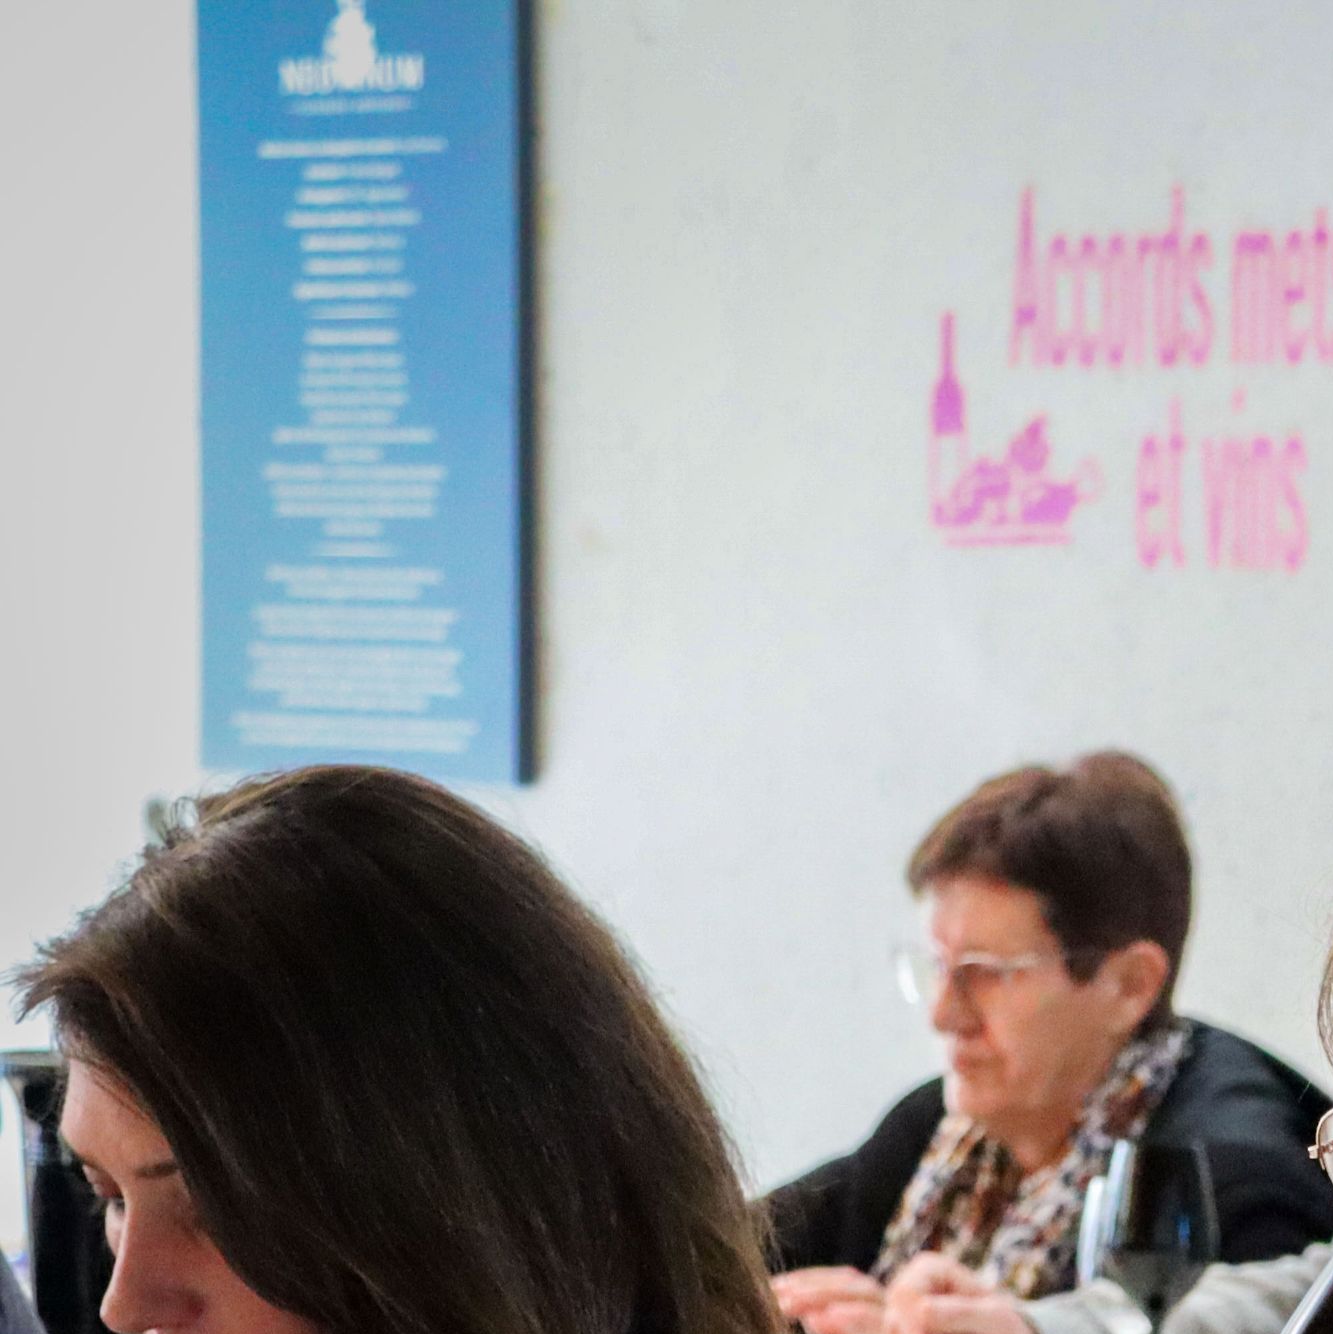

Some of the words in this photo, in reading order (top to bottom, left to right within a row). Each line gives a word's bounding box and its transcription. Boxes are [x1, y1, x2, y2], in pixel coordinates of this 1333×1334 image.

[1009, 185, 1214, 369] Accords
[1136, 400, 1188, 568] et
[1200, 389, 1309, 573] vins
